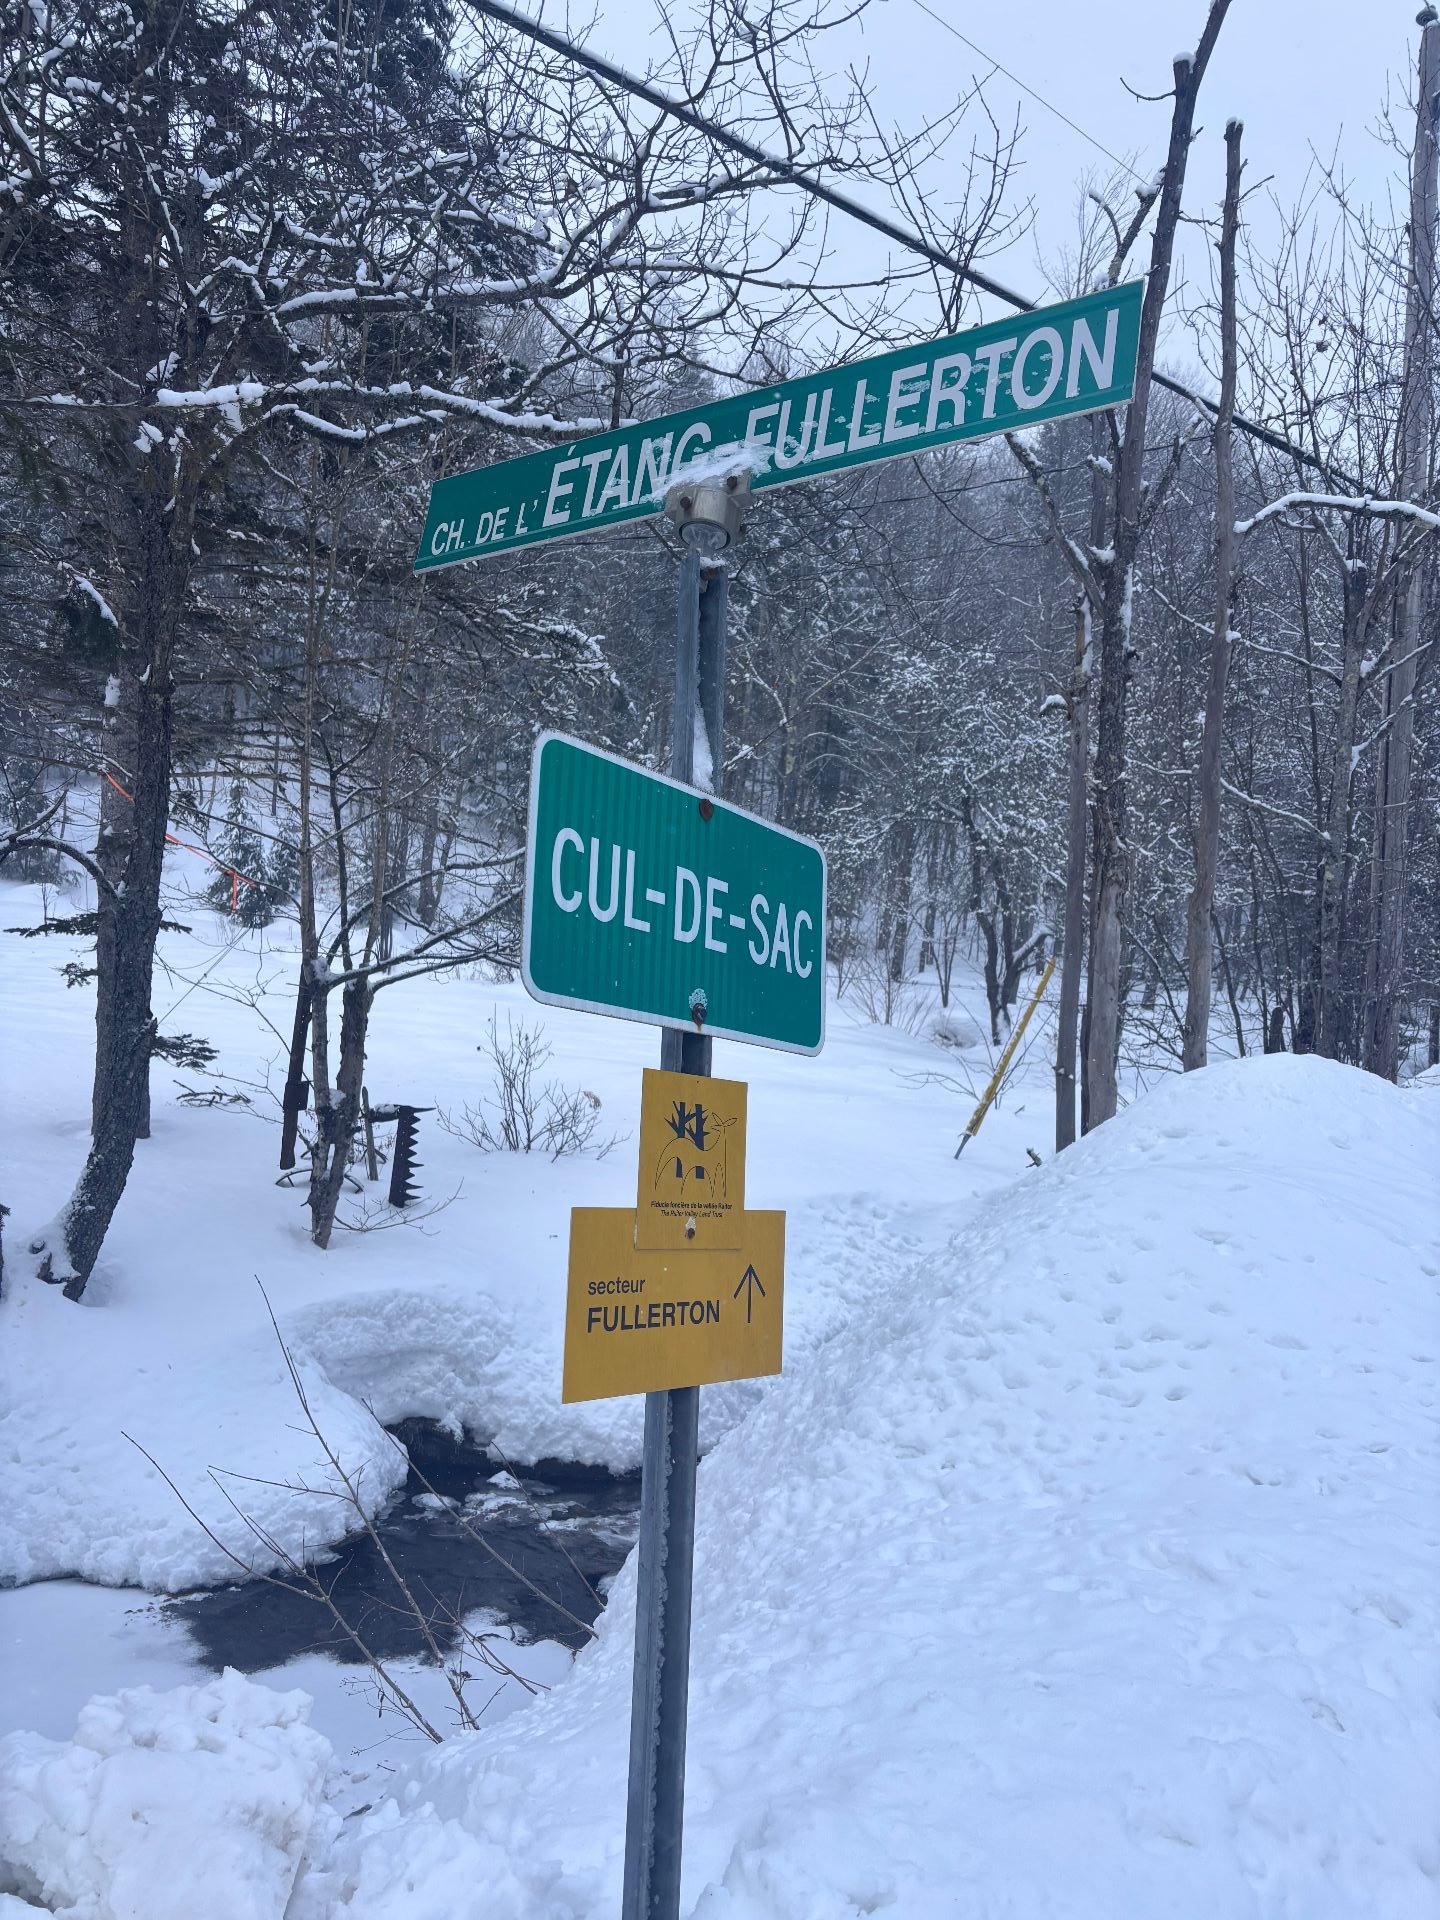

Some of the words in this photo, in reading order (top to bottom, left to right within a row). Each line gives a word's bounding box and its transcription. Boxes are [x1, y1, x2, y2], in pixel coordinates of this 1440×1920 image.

[431, 518, 465, 556] CH.
[475, 507, 510, 545] DE
[551, 827, 813, 979] CUL-DE-SAC
[588, 1277, 646, 1296] secteur
[587, 1299, 720, 1334] FULLERTON
